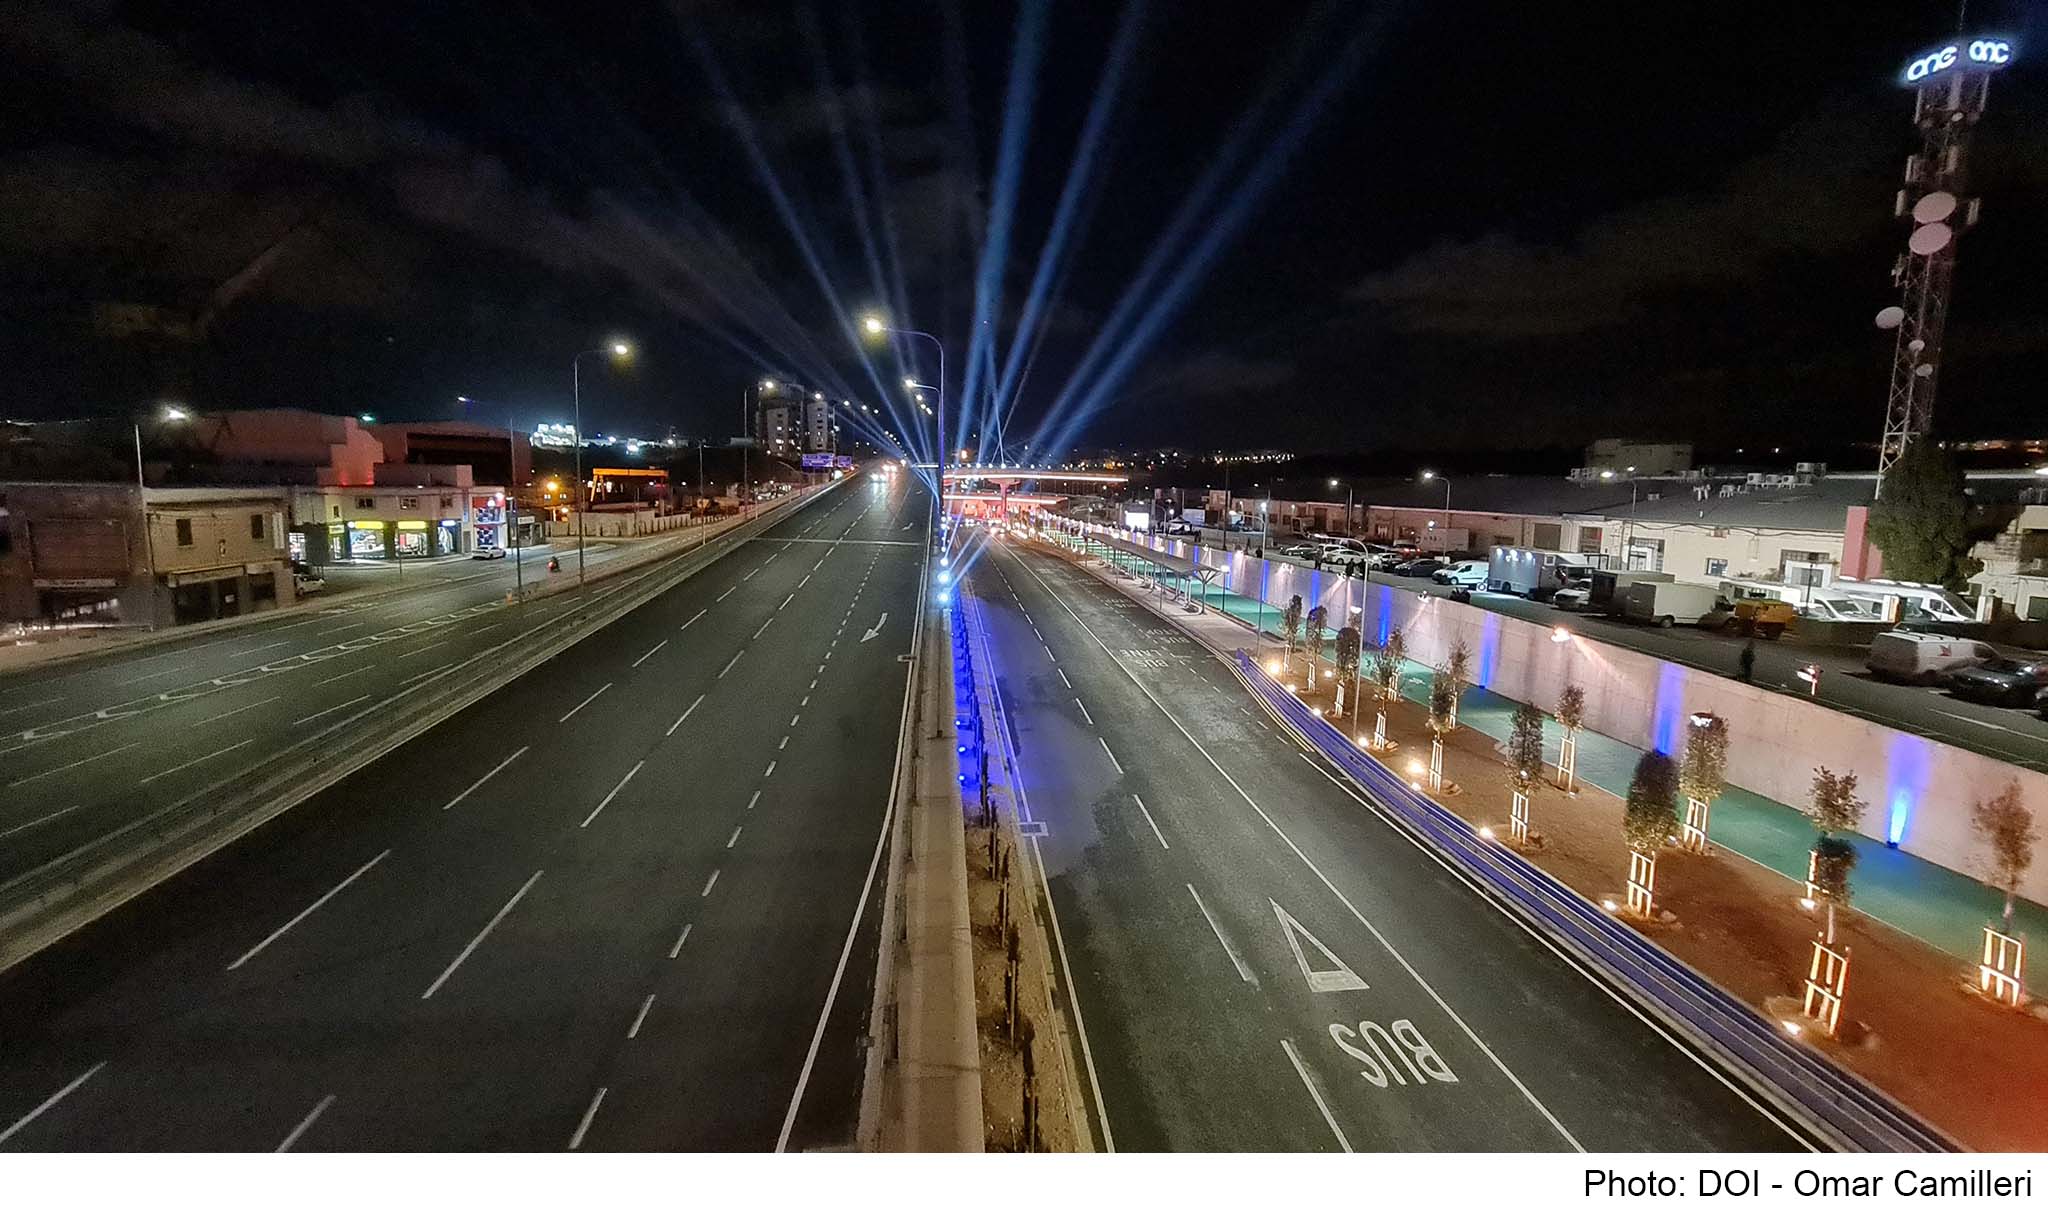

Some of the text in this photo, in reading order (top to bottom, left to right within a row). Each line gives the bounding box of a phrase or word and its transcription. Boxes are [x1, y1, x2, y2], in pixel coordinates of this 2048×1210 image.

[1120, 649, 1162, 657] LANE
[1135, 659, 1169, 668] BUS
[1328, 1019, 1460, 1089] BUS
